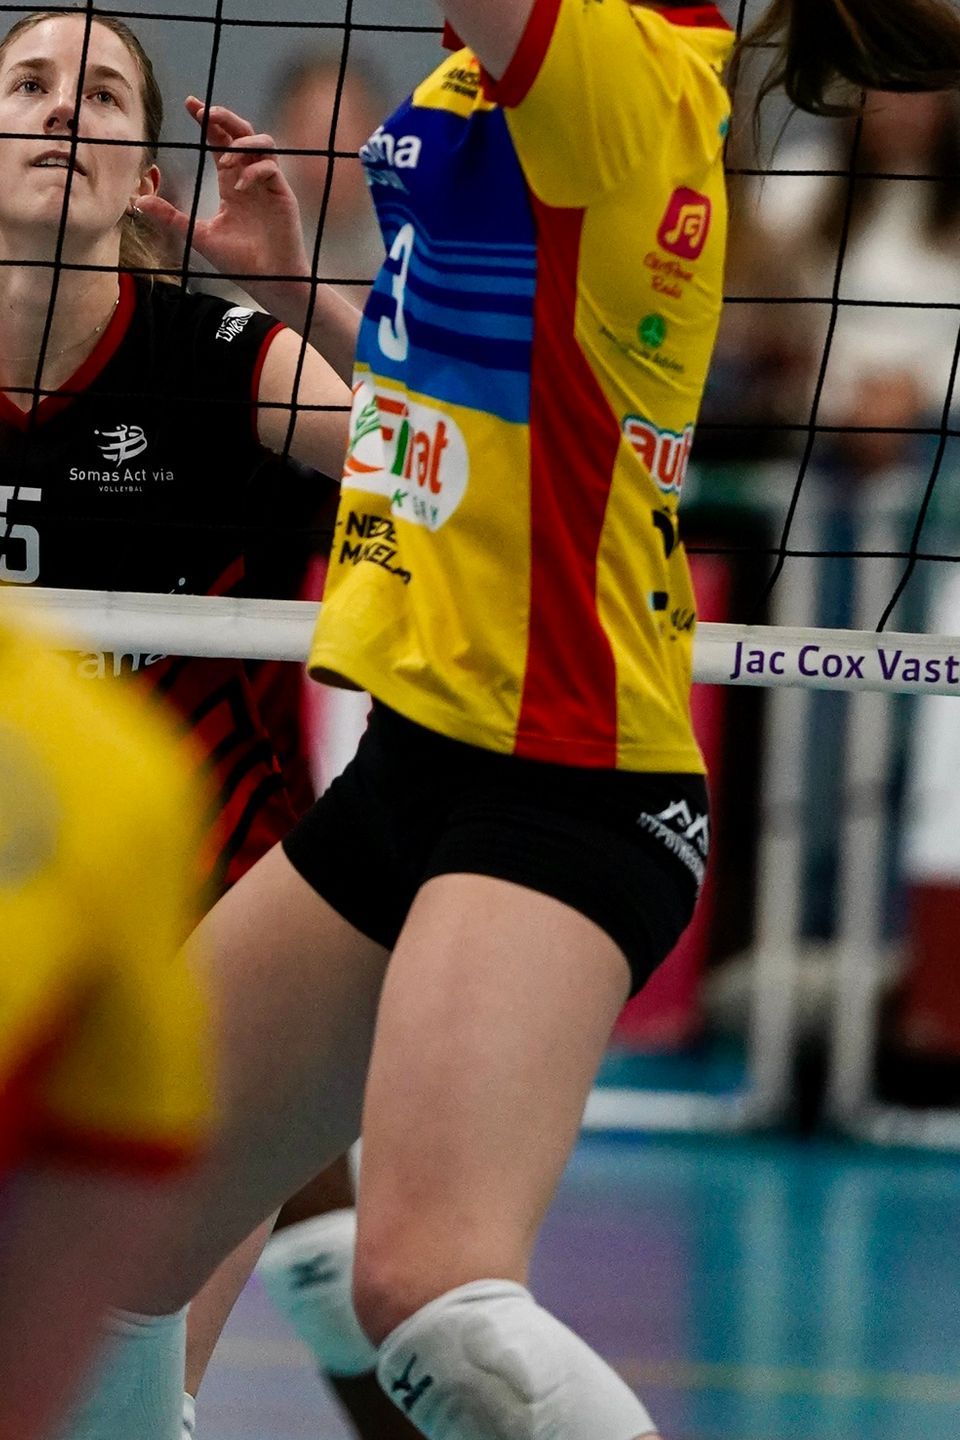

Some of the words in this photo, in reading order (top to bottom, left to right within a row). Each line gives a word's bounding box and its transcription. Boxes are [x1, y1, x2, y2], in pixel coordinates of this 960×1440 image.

[377, 222, 415, 362] 3
[68, 467, 120, 482] Somas
[123, 467, 175, 482] Actvia
[730, 641, 785, 680] Jac
[798, 645, 865, 679] Cox
[877, 649, 960, 684] Vast
